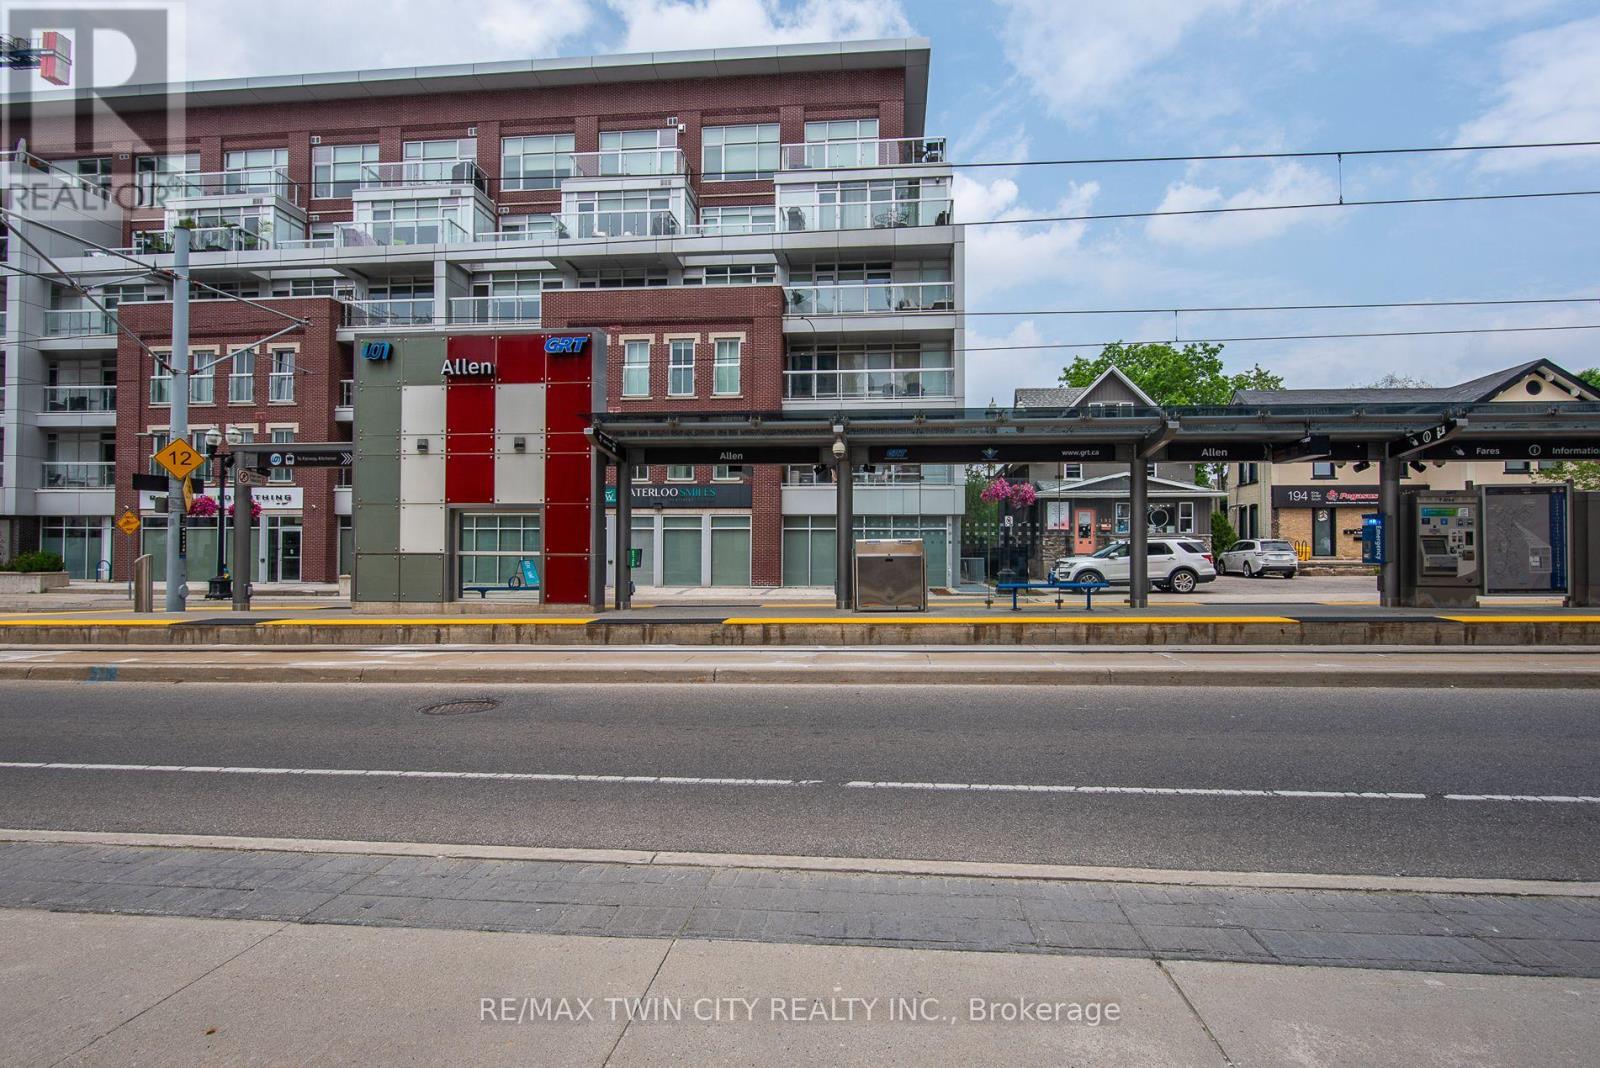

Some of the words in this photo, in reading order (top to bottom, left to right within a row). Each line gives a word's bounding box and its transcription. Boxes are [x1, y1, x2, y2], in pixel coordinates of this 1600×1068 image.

[544, 336, 587, 353] GRT
[441, 359, 492, 374] Allen
[719, 451, 744, 460] Allen
[1061, 448, 1100, 458] www.grt.ca
[1201, 447, 1228, 457] Allen
[1476, 447, 1500, 455] Fares
[1552, 446, 1600, 455] Informatio
[169, 451, 192, 466] 12
[631, 487, 679, 497] ATERLOO
[1287, 490, 1309, 501] 194
[1374, 525, 1382, 560] Emergency
